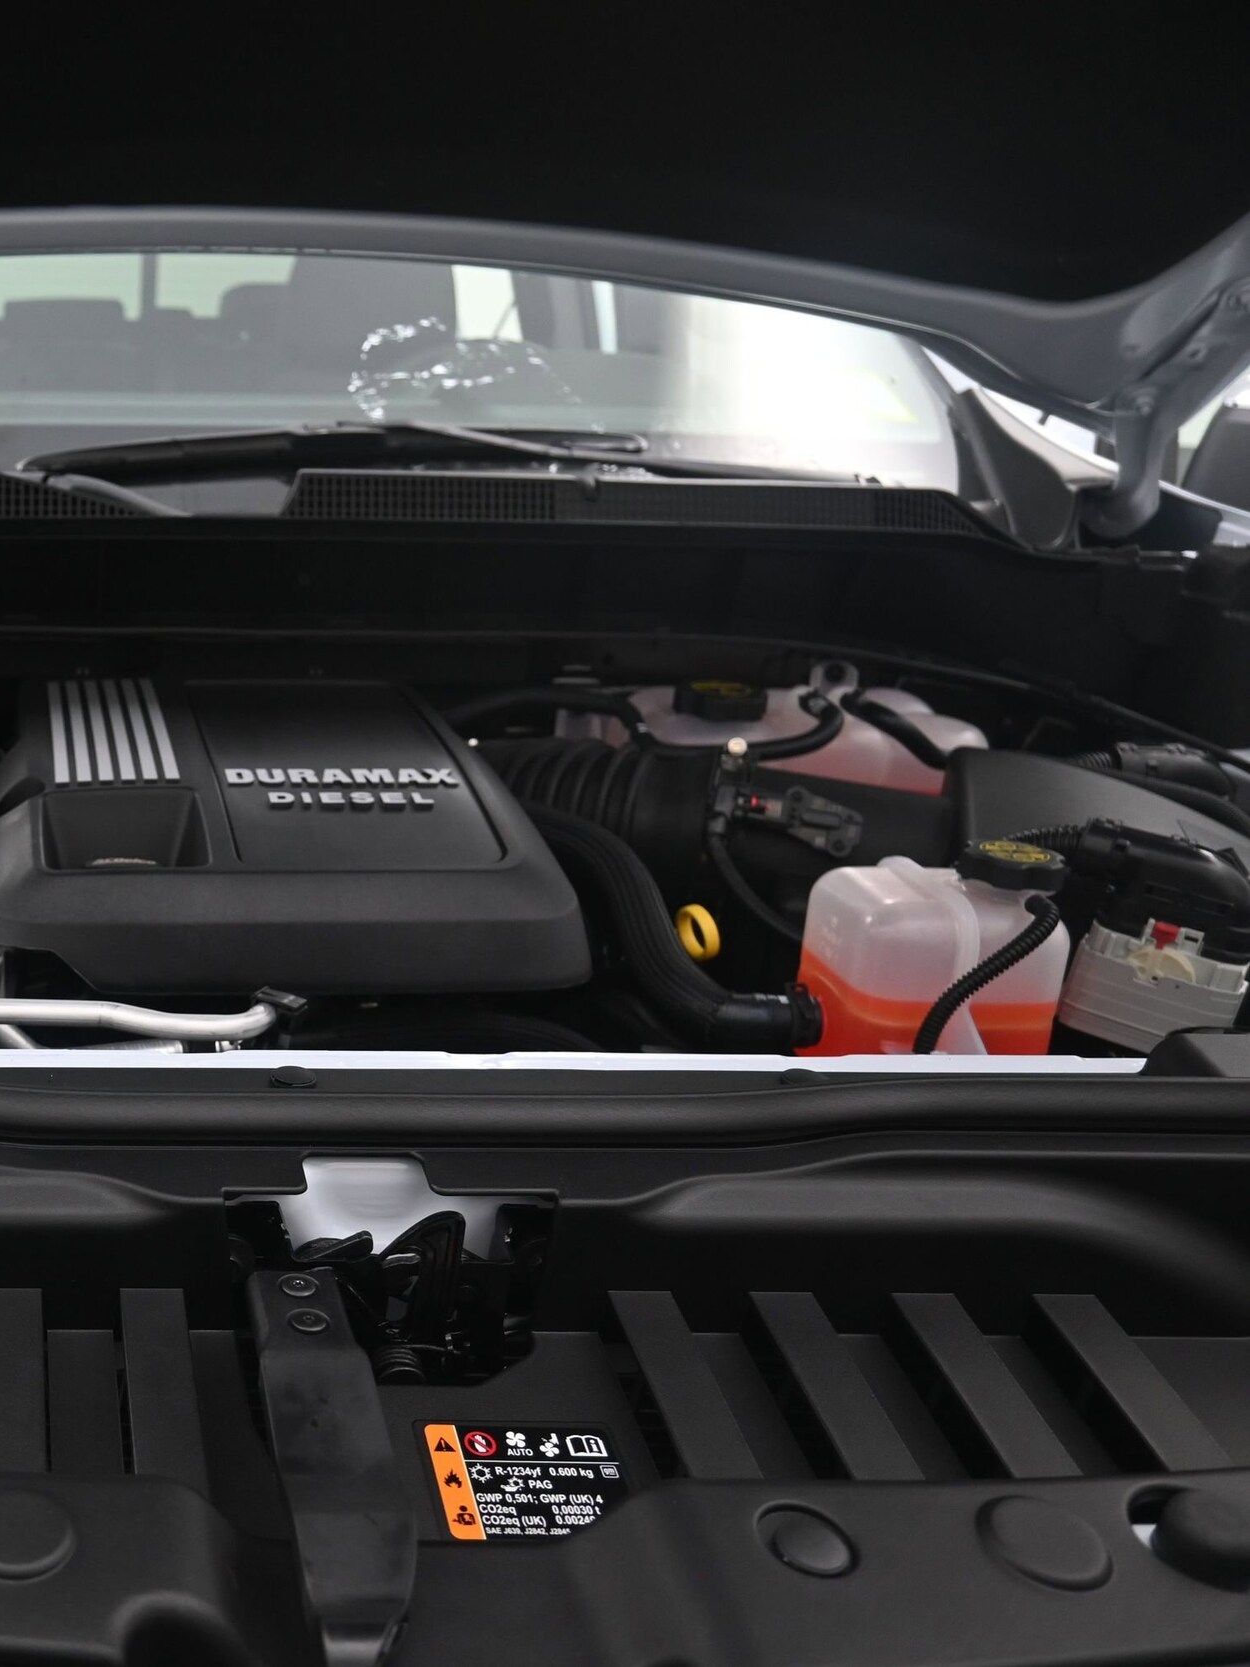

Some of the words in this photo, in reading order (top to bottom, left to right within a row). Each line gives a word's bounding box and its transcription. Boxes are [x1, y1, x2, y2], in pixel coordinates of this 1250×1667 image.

[224, 768, 459, 786] DURAMAX
[267, 791, 435, 806] DIESEL
[507, 1448, 533, 1457] AUTO
[495, 1466, 542, 1478] R-1234yf
[549, 1467, 578, 1477] 0.600
[578, 1468, 594, 1479] kg
[528, 1480, 553, 1490] PAG
[476, 1493, 503, 1503] GWP
[505, 1493, 538, 1504] 0,501;
[539, 1494, 567, 1504] GWP
[569, 1494, 595, 1506] (UK)
[595, 1495, 604, 1504] 4
[479, 1504, 518, 1515] CO2eq
[551, 1505, 594, 1516] 0,00030
[594, 1506, 602, 1515] t
[482, 1515, 521, 1527] CO2eq
[521, 1516, 547, 1527] (UK)
[485, 1527, 502, 1535] SAE
